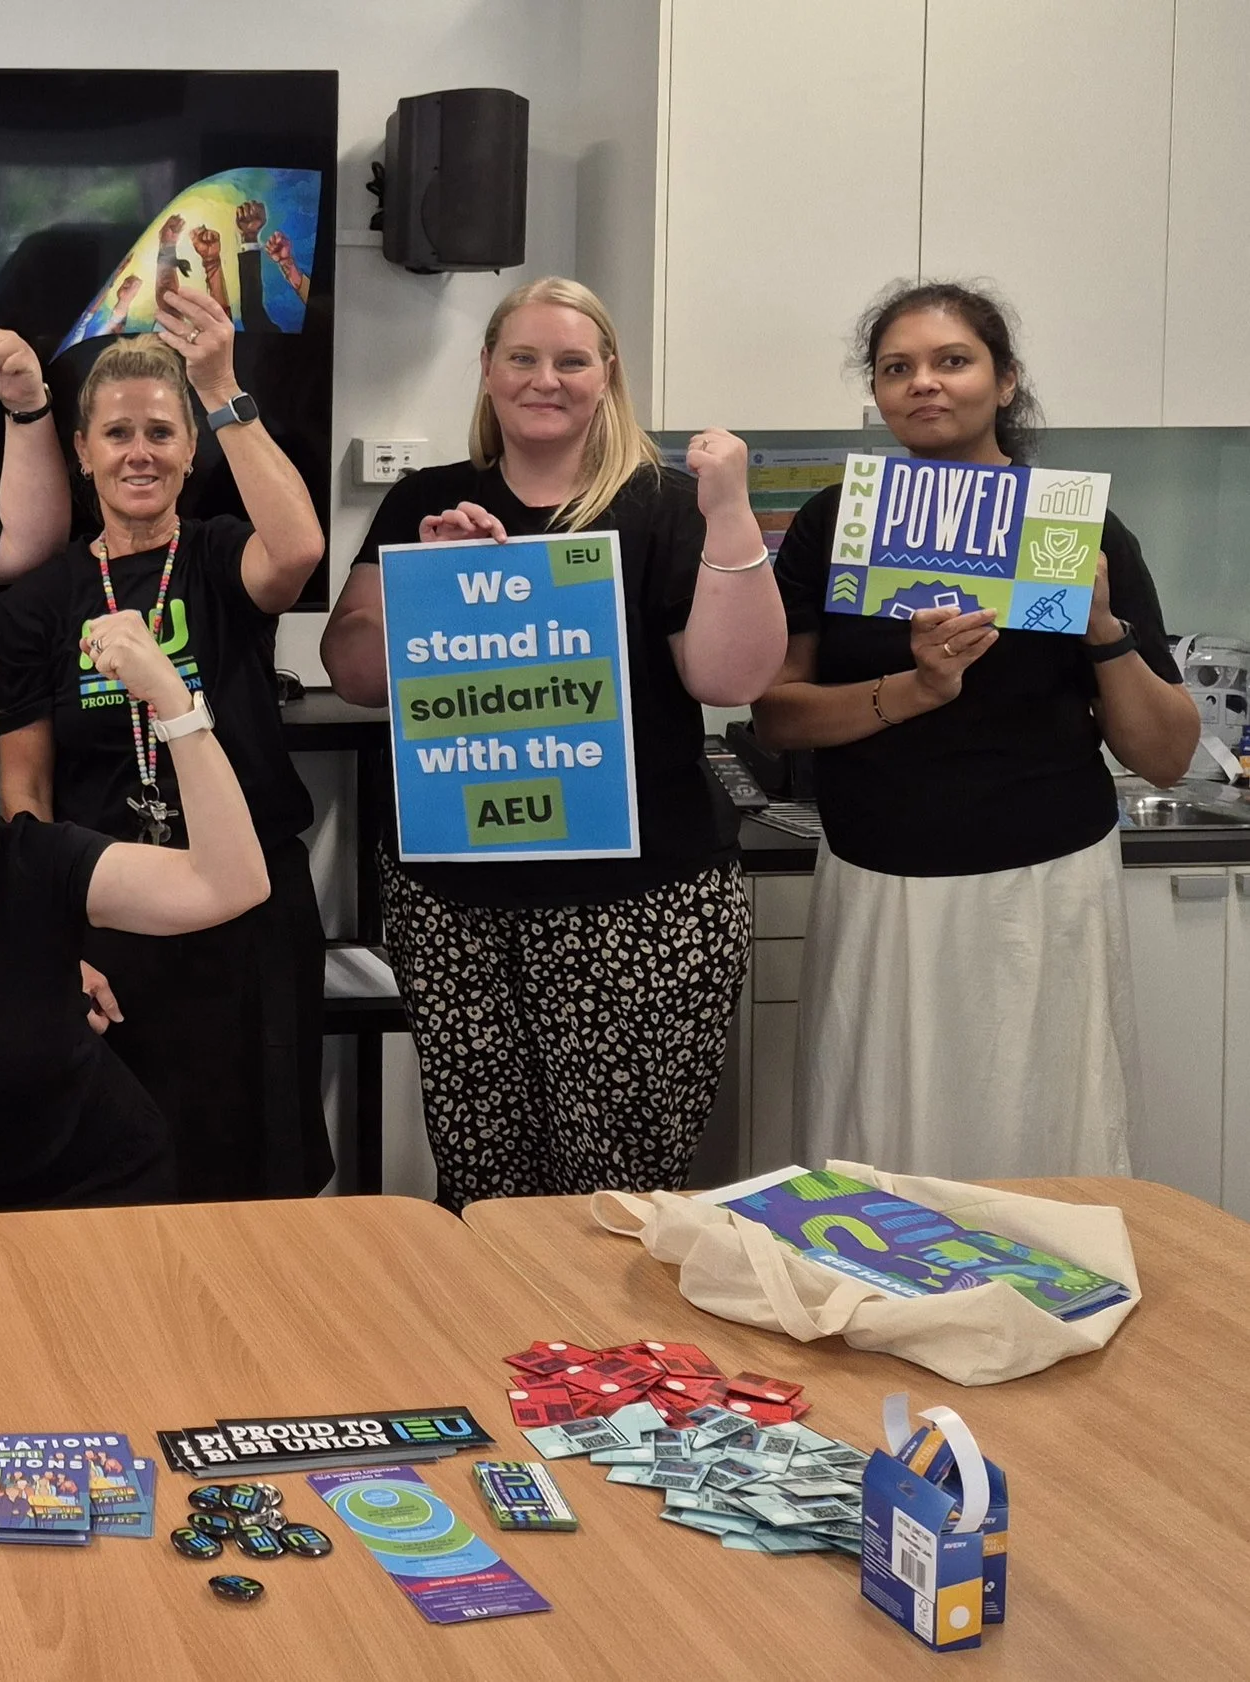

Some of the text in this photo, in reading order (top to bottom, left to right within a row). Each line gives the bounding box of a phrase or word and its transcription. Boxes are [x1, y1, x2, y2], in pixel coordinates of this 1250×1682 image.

[839, 461, 877, 560] UNION
[881, 463, 1018, 558] POWER
[565, 548, 601, 565] IEU
[457, 570, 532, 605] We
[406, 619, 591, 663] stand in
[81, 694, 125, 709] PROUD
[410, 675, 603, 723] solidarity
[416, 735, 603, 774] with the
[476, 794, 553, 828] AEU
[819, 1255, 861, 1271] REP
[227, 1419, 383, 1441] PROUD TO
[391, 1418, 472, 1440] IEU
[235, 1440, 277, 1455] BE
[280, 1433, 391, 1452] UNION
[242, 1525, 276, 1553] IEU
[287, 1528, 327, 1547] IEU
